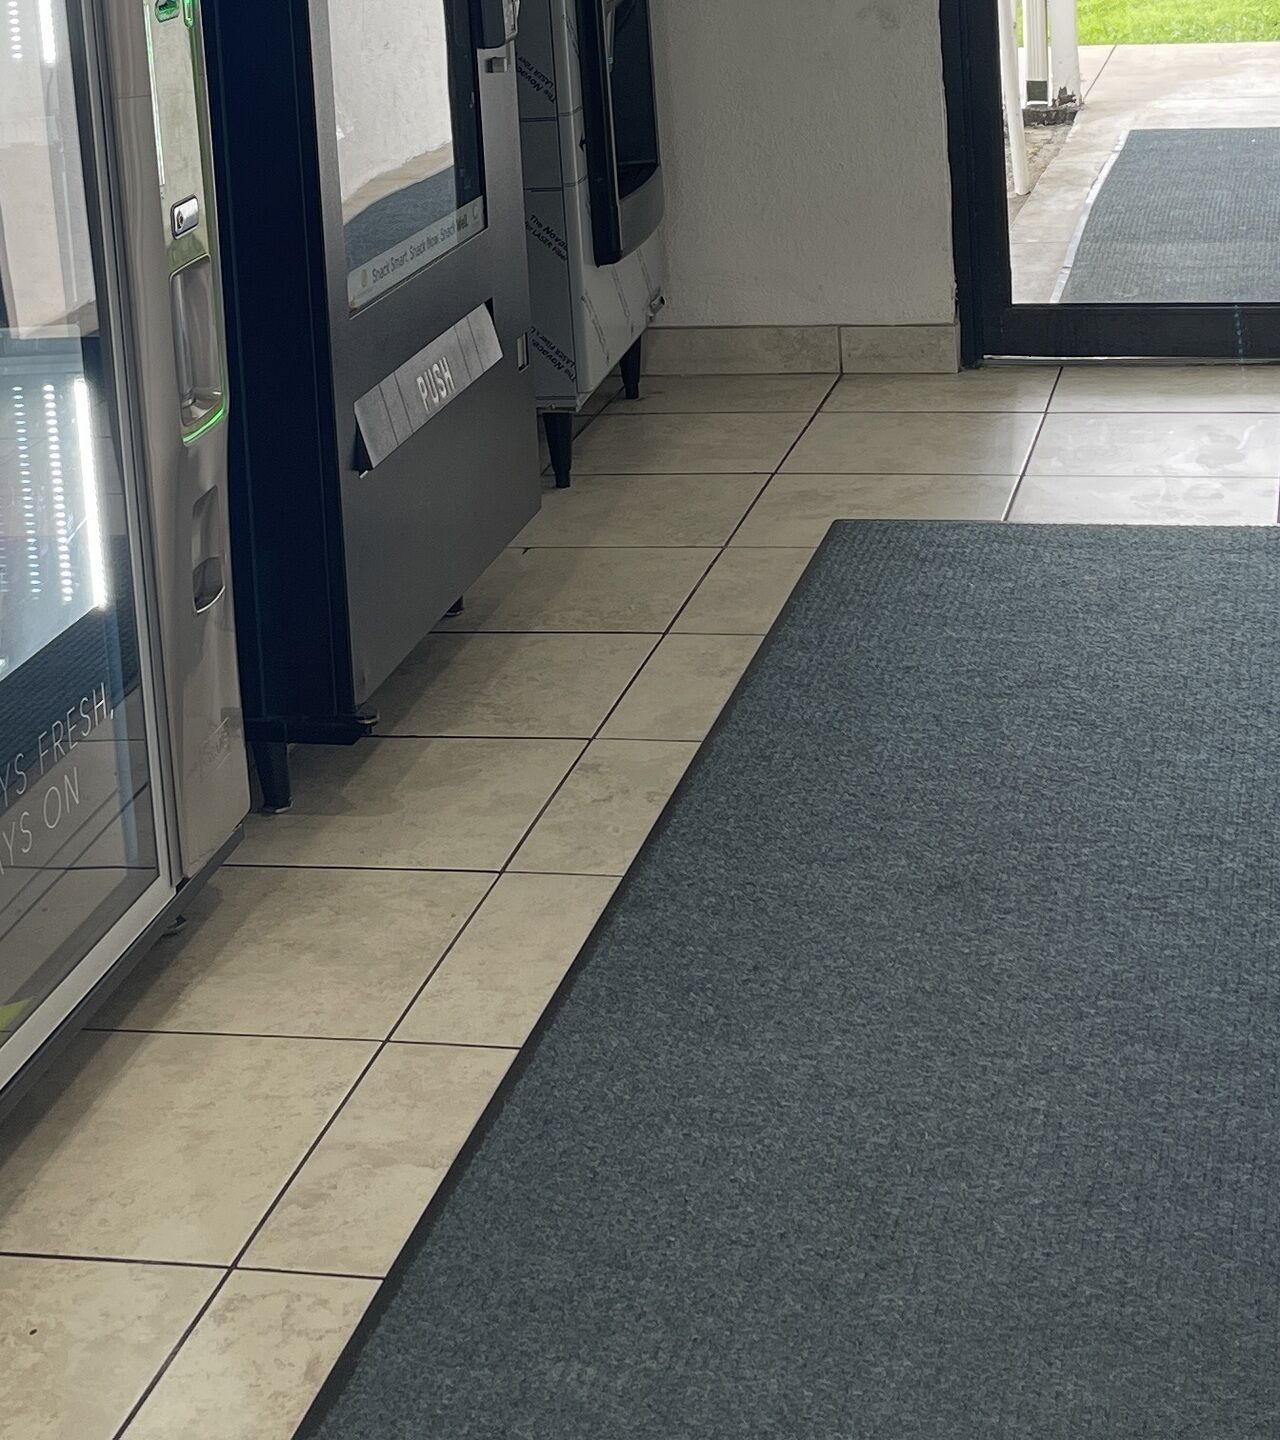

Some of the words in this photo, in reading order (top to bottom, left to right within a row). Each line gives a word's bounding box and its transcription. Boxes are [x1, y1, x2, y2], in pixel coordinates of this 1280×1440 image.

[416, 357, 456, 412] PUSH
[38, 682, 115, 775] FRESH,
[42, 767, 80, 829] ON
